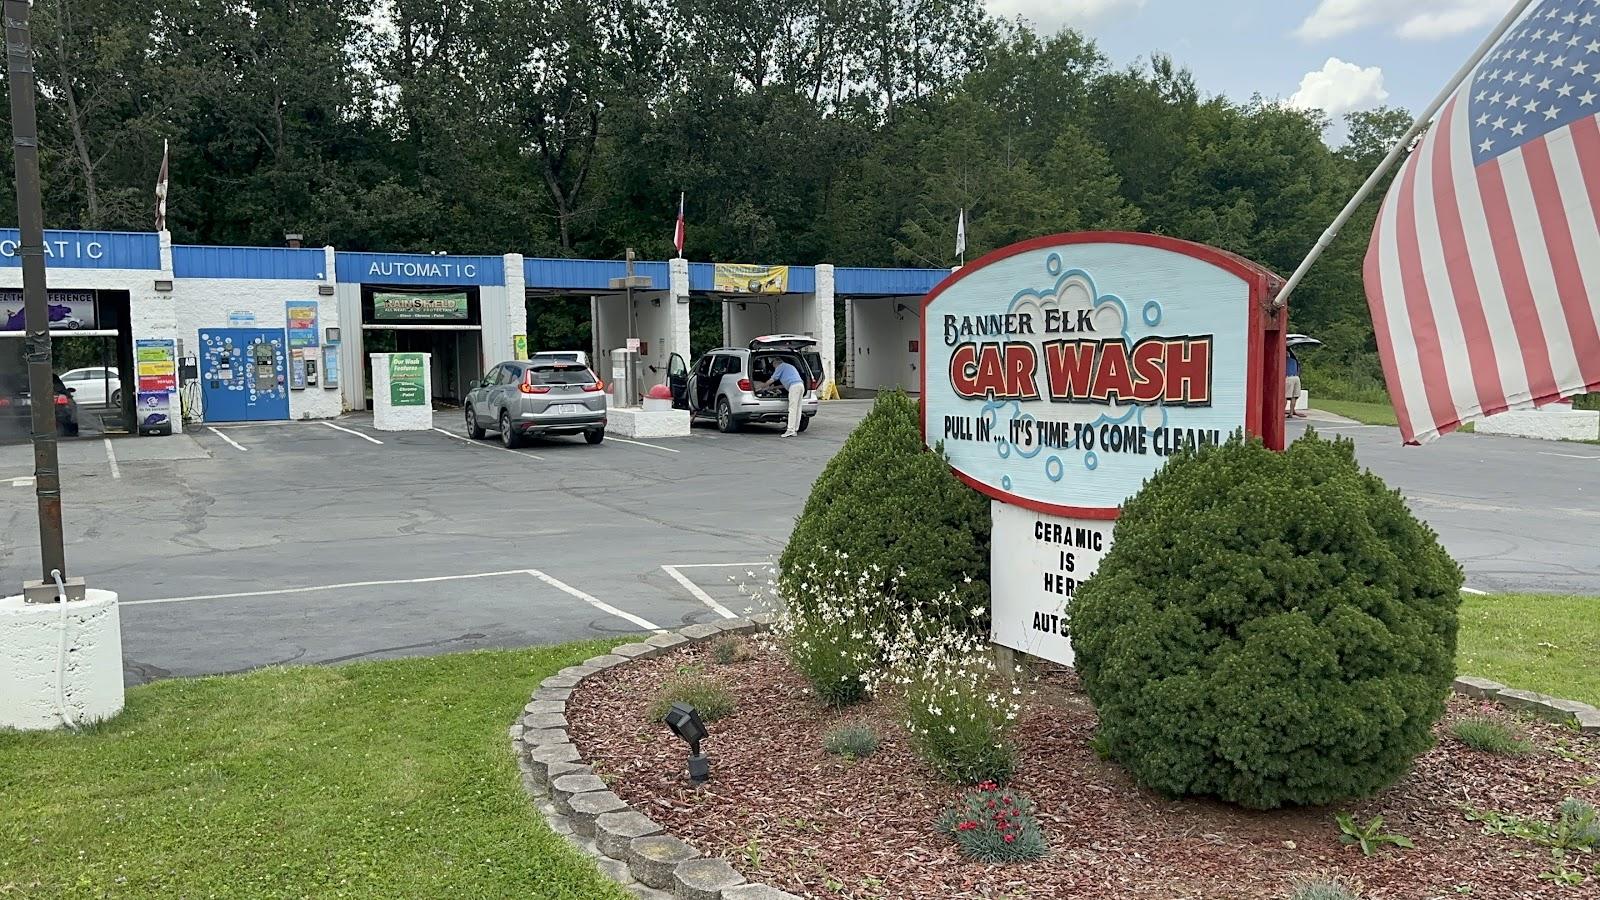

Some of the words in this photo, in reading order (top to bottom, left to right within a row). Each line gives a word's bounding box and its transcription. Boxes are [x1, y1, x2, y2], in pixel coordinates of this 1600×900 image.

[0, 239, 104, 259] OATIC
[368, 261, 477, 278] AUTOMATIC
[944, 314, 1035, 346] BANNER
[1044, 309, 1096, 334] ELK
[949, 340, 1043, 401] CAR
[1042, 333, 1214, 407] WASH
[944, 415, 973, 441] PULL
[1009, 419, 1033, 446] IT'S
[1036, 421, 1069, 448] TIME
[1074, 423, 1095, 451] TO
[1100, 424, 1147, 454] COME
[1034, 520, 1103, 552] CERAMIC
[1059, 551, 1075, 573] IS
[1044, 572, 1084, 597] HER
